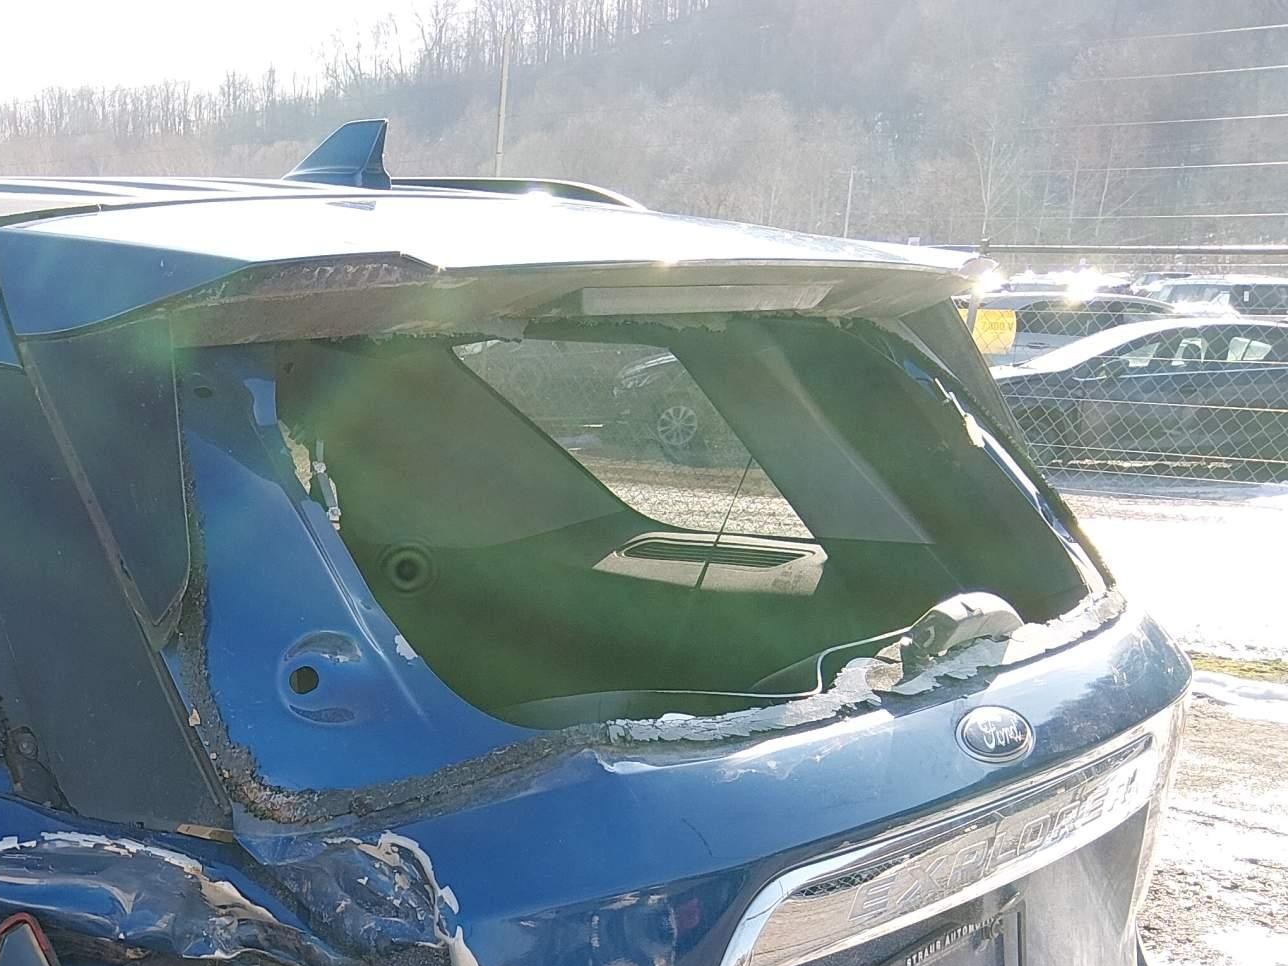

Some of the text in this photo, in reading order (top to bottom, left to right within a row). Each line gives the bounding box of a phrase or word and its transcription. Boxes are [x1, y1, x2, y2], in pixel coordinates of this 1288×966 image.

[976, 717, 1025, 750] Ford
[848, 767, 1138, 922] EXPLORER
[945, 917, 996, 946] AUTOMO
